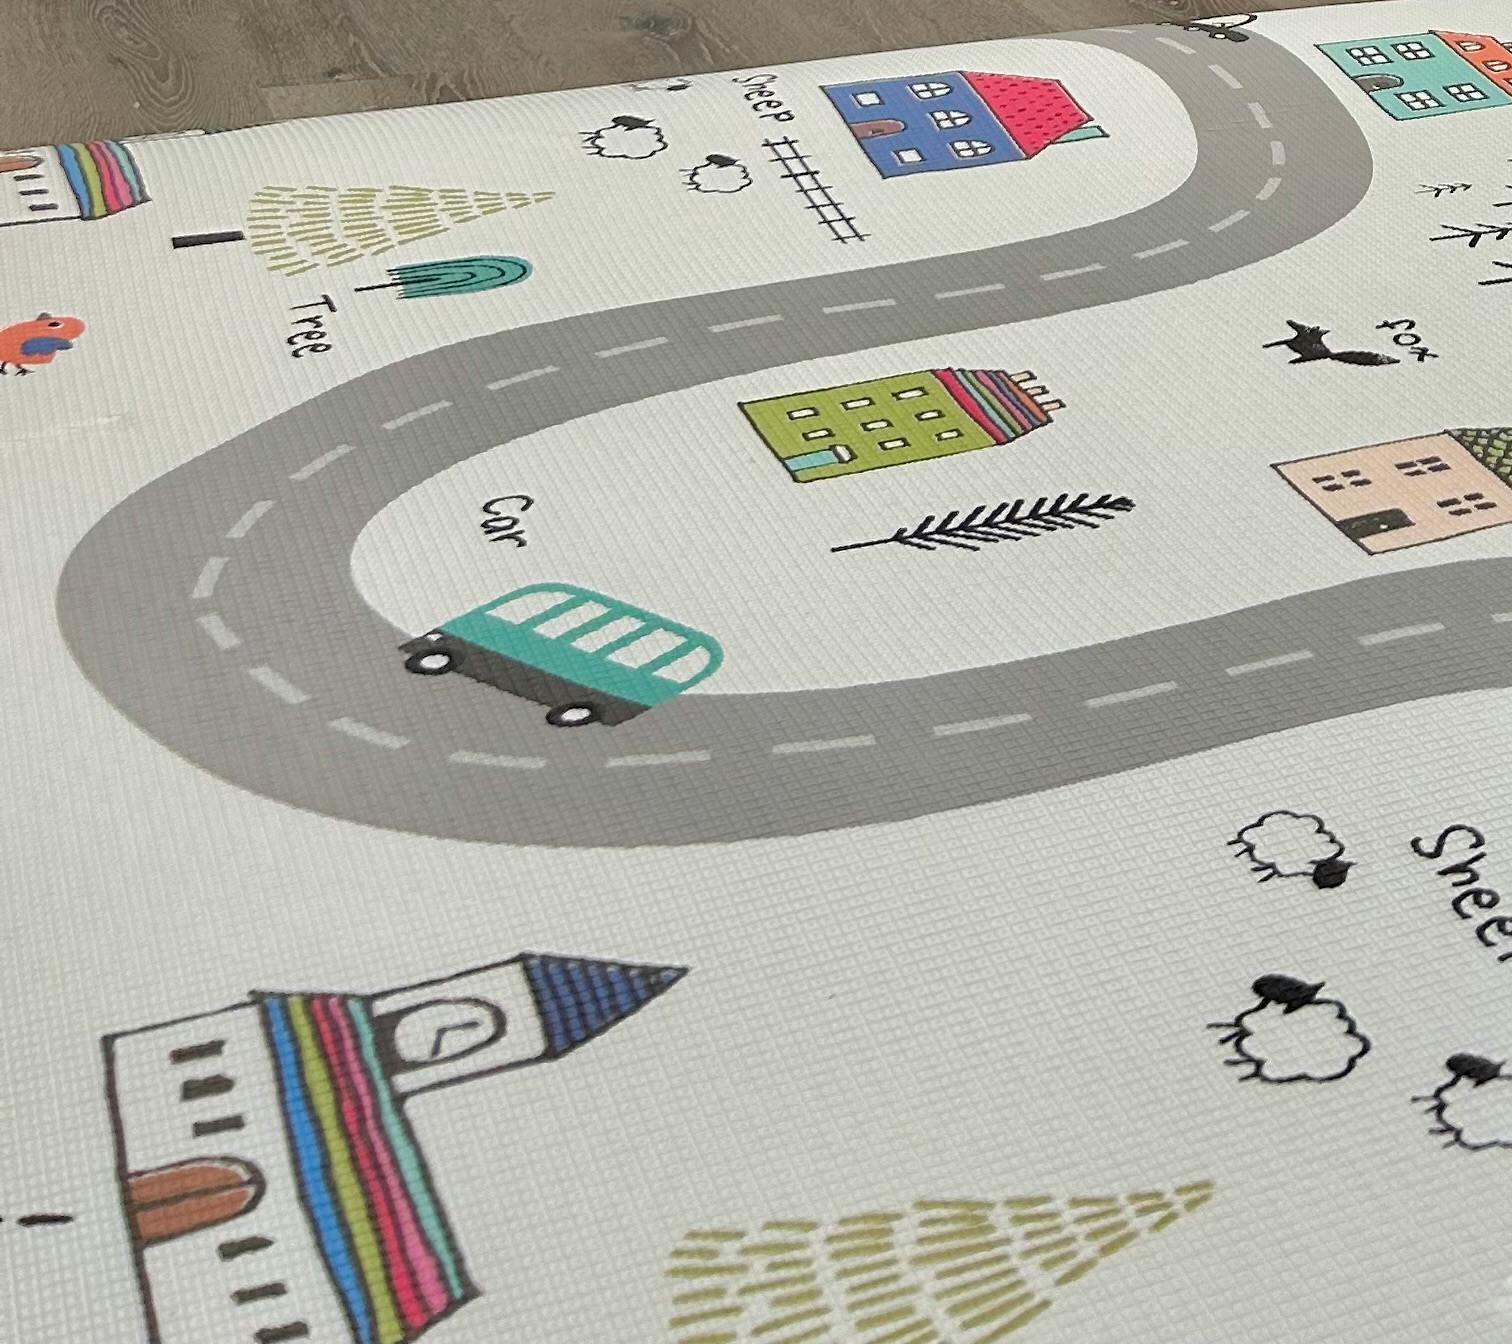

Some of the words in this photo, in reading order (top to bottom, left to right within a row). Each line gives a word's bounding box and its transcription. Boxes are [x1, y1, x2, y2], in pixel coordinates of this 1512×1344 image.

[732, 74, 796, 122] Sheep
[287, 294, 338, 358] Tree
[480, 494, 535, 548] Car
